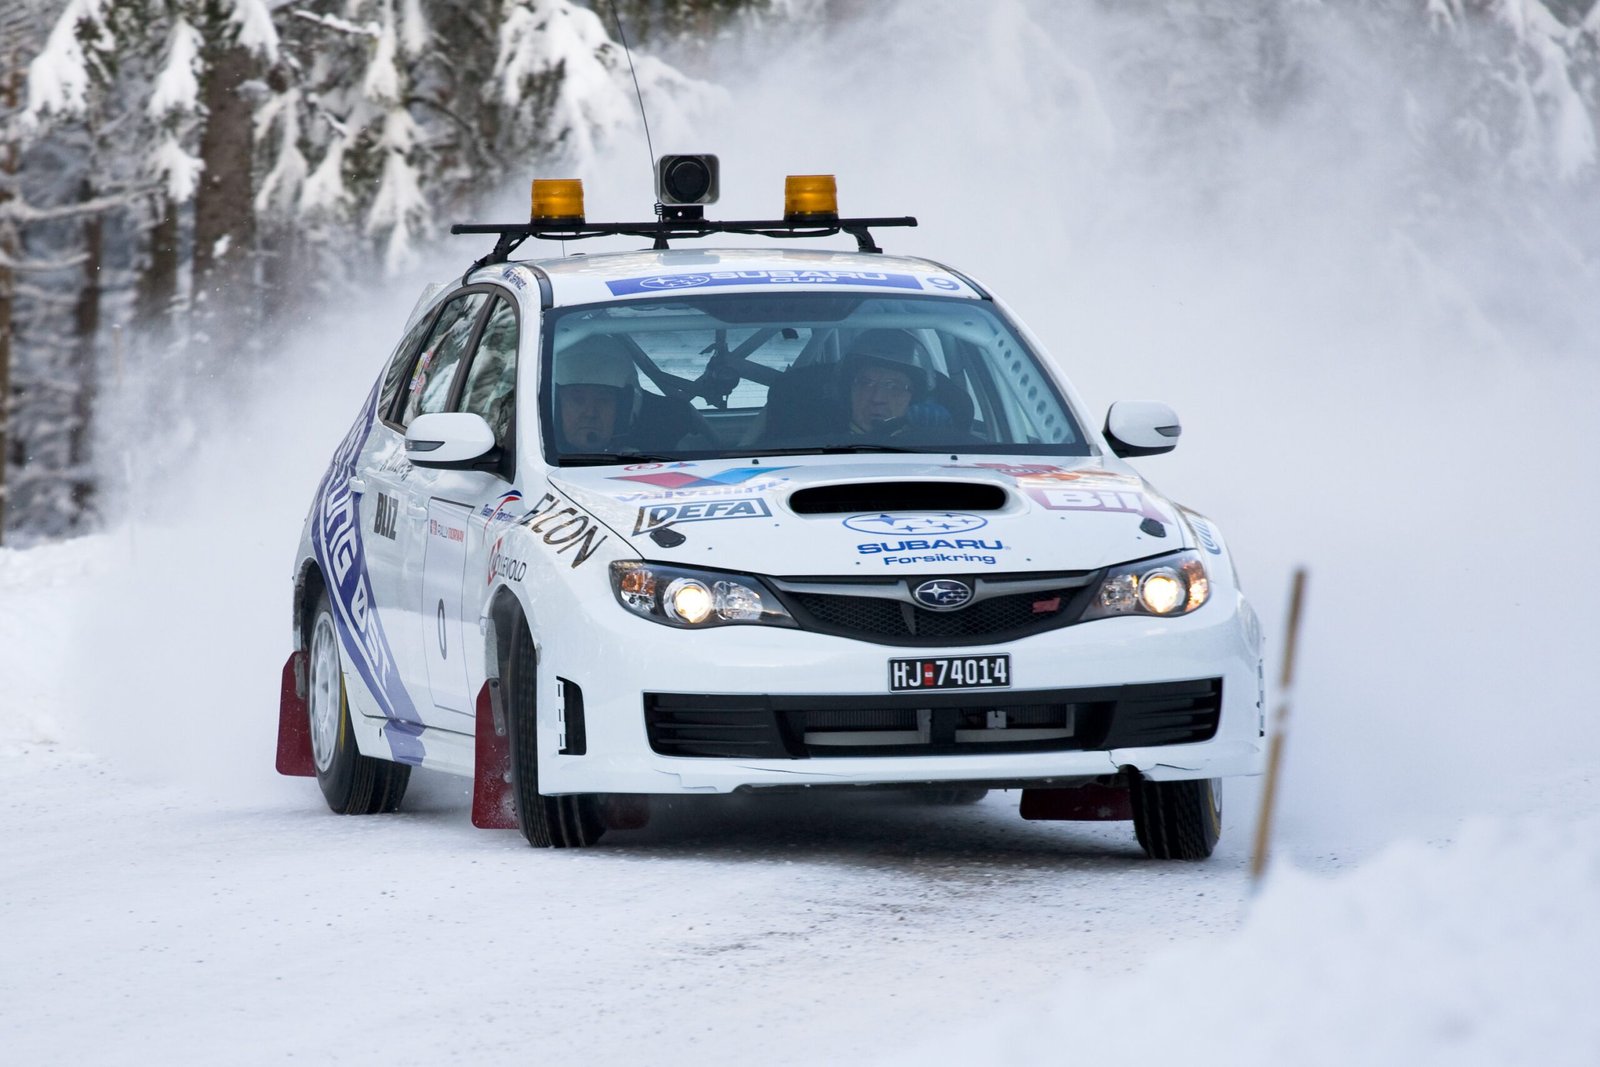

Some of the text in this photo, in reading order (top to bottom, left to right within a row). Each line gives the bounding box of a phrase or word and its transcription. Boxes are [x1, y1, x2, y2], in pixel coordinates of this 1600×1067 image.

[709, 270, 888, 281] SUBARU
[647, 501, 757, 528] DEFA
[519, 492, 608, 569] ELCON
[857, 539, 1003, 555] SUBARU
[883, 553, 997, 565] Forsikring
[893, 658, 1007, 687] HJ 74014
